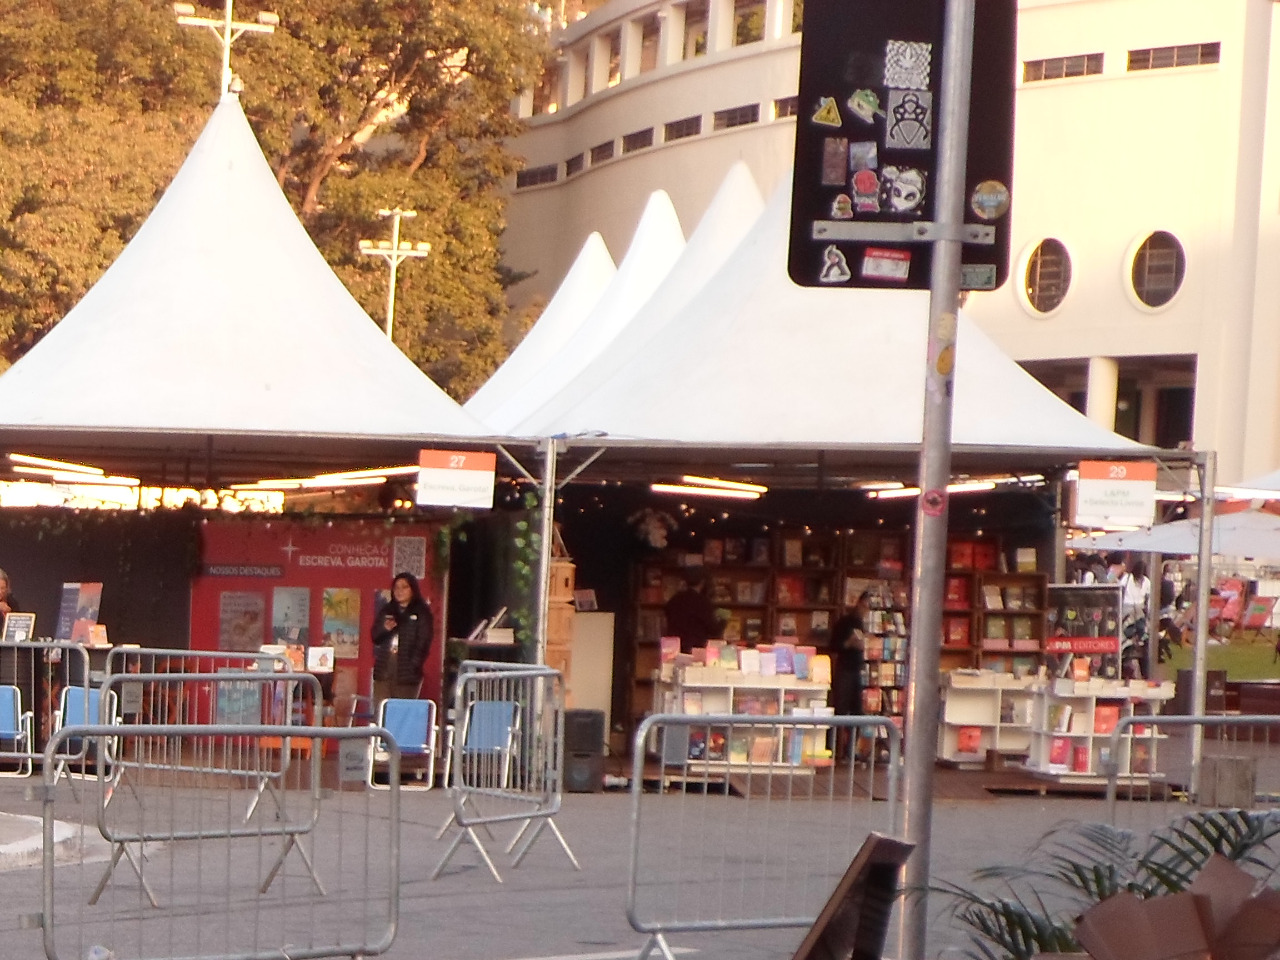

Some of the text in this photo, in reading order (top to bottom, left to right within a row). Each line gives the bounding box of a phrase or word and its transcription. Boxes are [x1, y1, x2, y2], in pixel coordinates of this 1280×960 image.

[449, 455, 467, 468] 27
[1109, 465, 1127, 479] 29
[347, 556, 389, 568] GAROTA!
[209, 566, 281, 577] NOSSOS DESTAQUES
